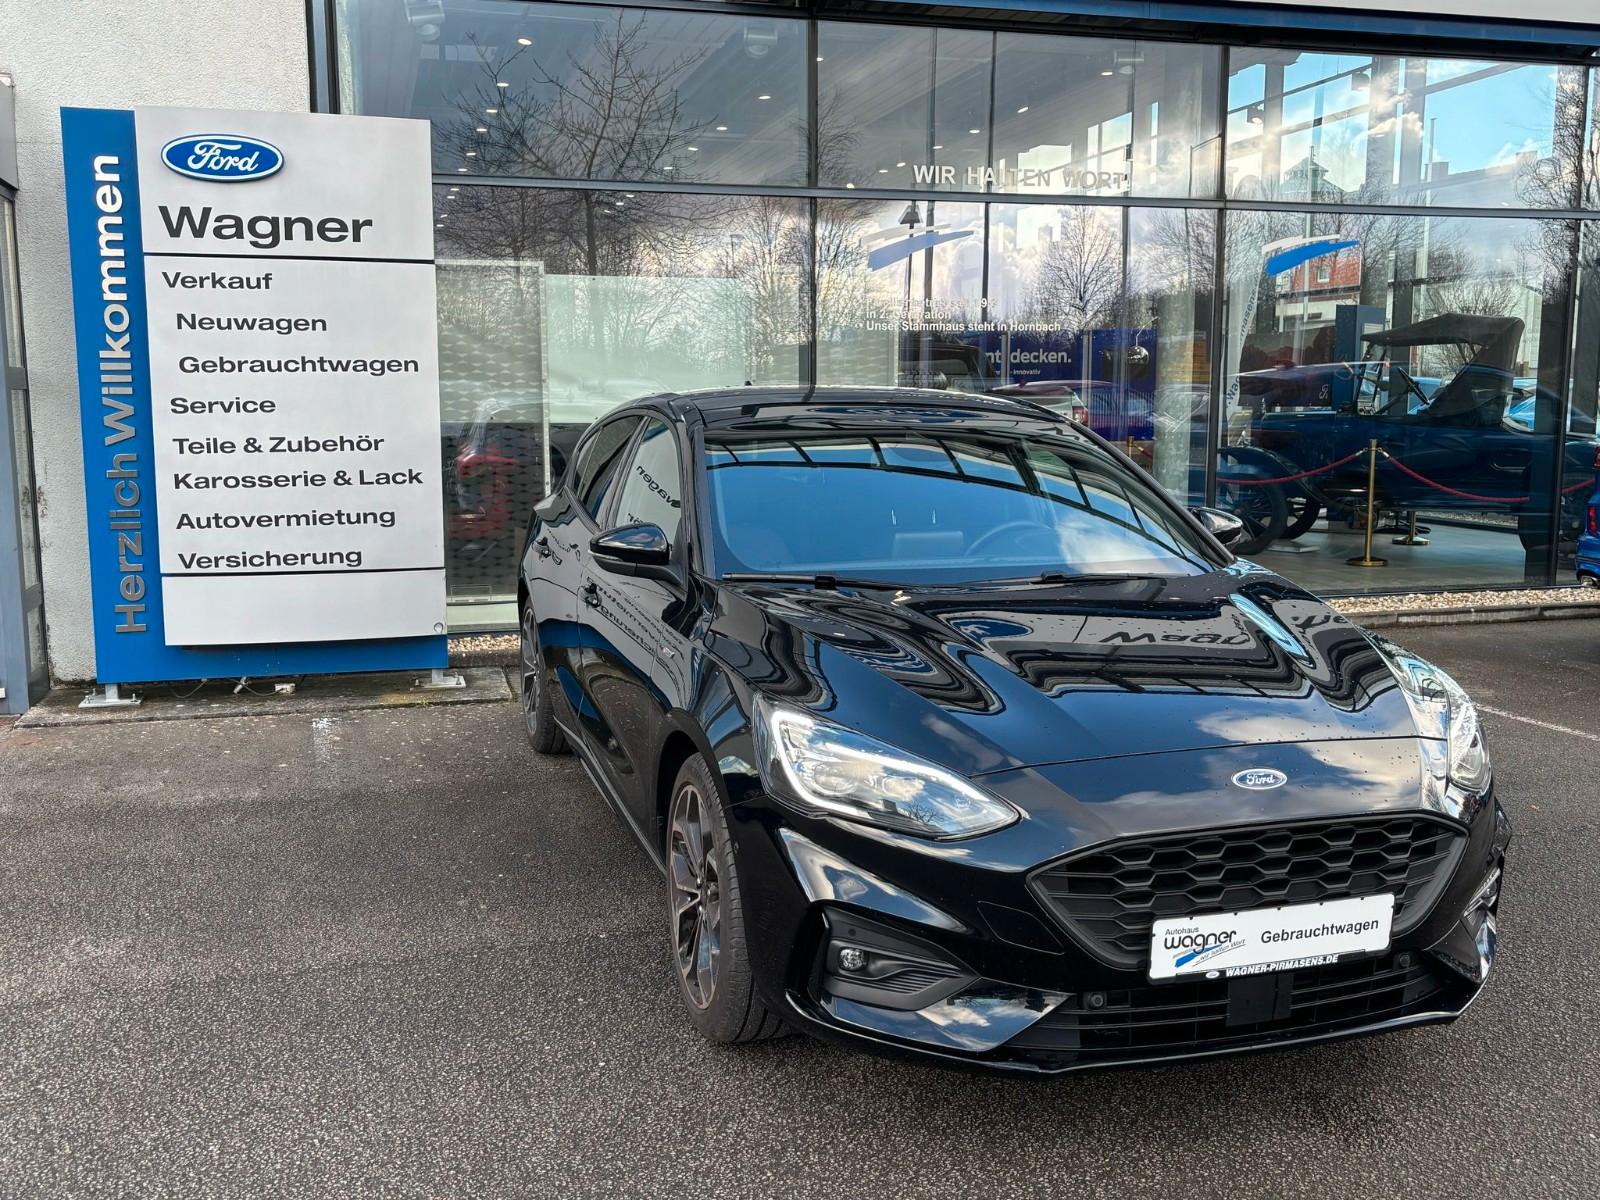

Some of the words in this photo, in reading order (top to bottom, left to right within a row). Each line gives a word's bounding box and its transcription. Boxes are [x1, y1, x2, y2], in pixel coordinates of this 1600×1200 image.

[186, 141, 259, 173] Ford
[913, 165, 957, 185] WIR
[967, 165, 1051, 188] HALTEN
[158, 205, 373, 250] Wagner
[161, 271, 273, 290] Verkauf
[93, 155, 136, 446] Willkommen
[176, 313, 327, 336] Neuwagen
[901, 320, 965, 332] Stammhaus
[968, 321, 995, 332] steht
[998, 321, 1007, 332] in
[1010, 321, 1061, 333] Hornbach
[178, 355, 419, 377] Gebrauchtwagen
[170, 396, 276, 415] Service
[172, 437, 237, 455] Teile
[243, 437, 264, 454] &
[269, 435, 385, 453] Zubehör
[173, 470, 327, 490] Karosserie
[333, 470, 353, 487] &
[358, 468, 424, 486] Lack
[175, 509, 396, 530] Autovermietung
[106, 453, 147, 633] Herzlich
[177, 550, 362, 569] Versicherung
[1164, 930, 1236, 954] wagner
[1165, 926, 1200, 936] Autohaus
[1260, 919, 1380, 944] Gebrauchtwagen
[1225, 954, 1339, 977] WAGNER-PIRMASENS.DE
